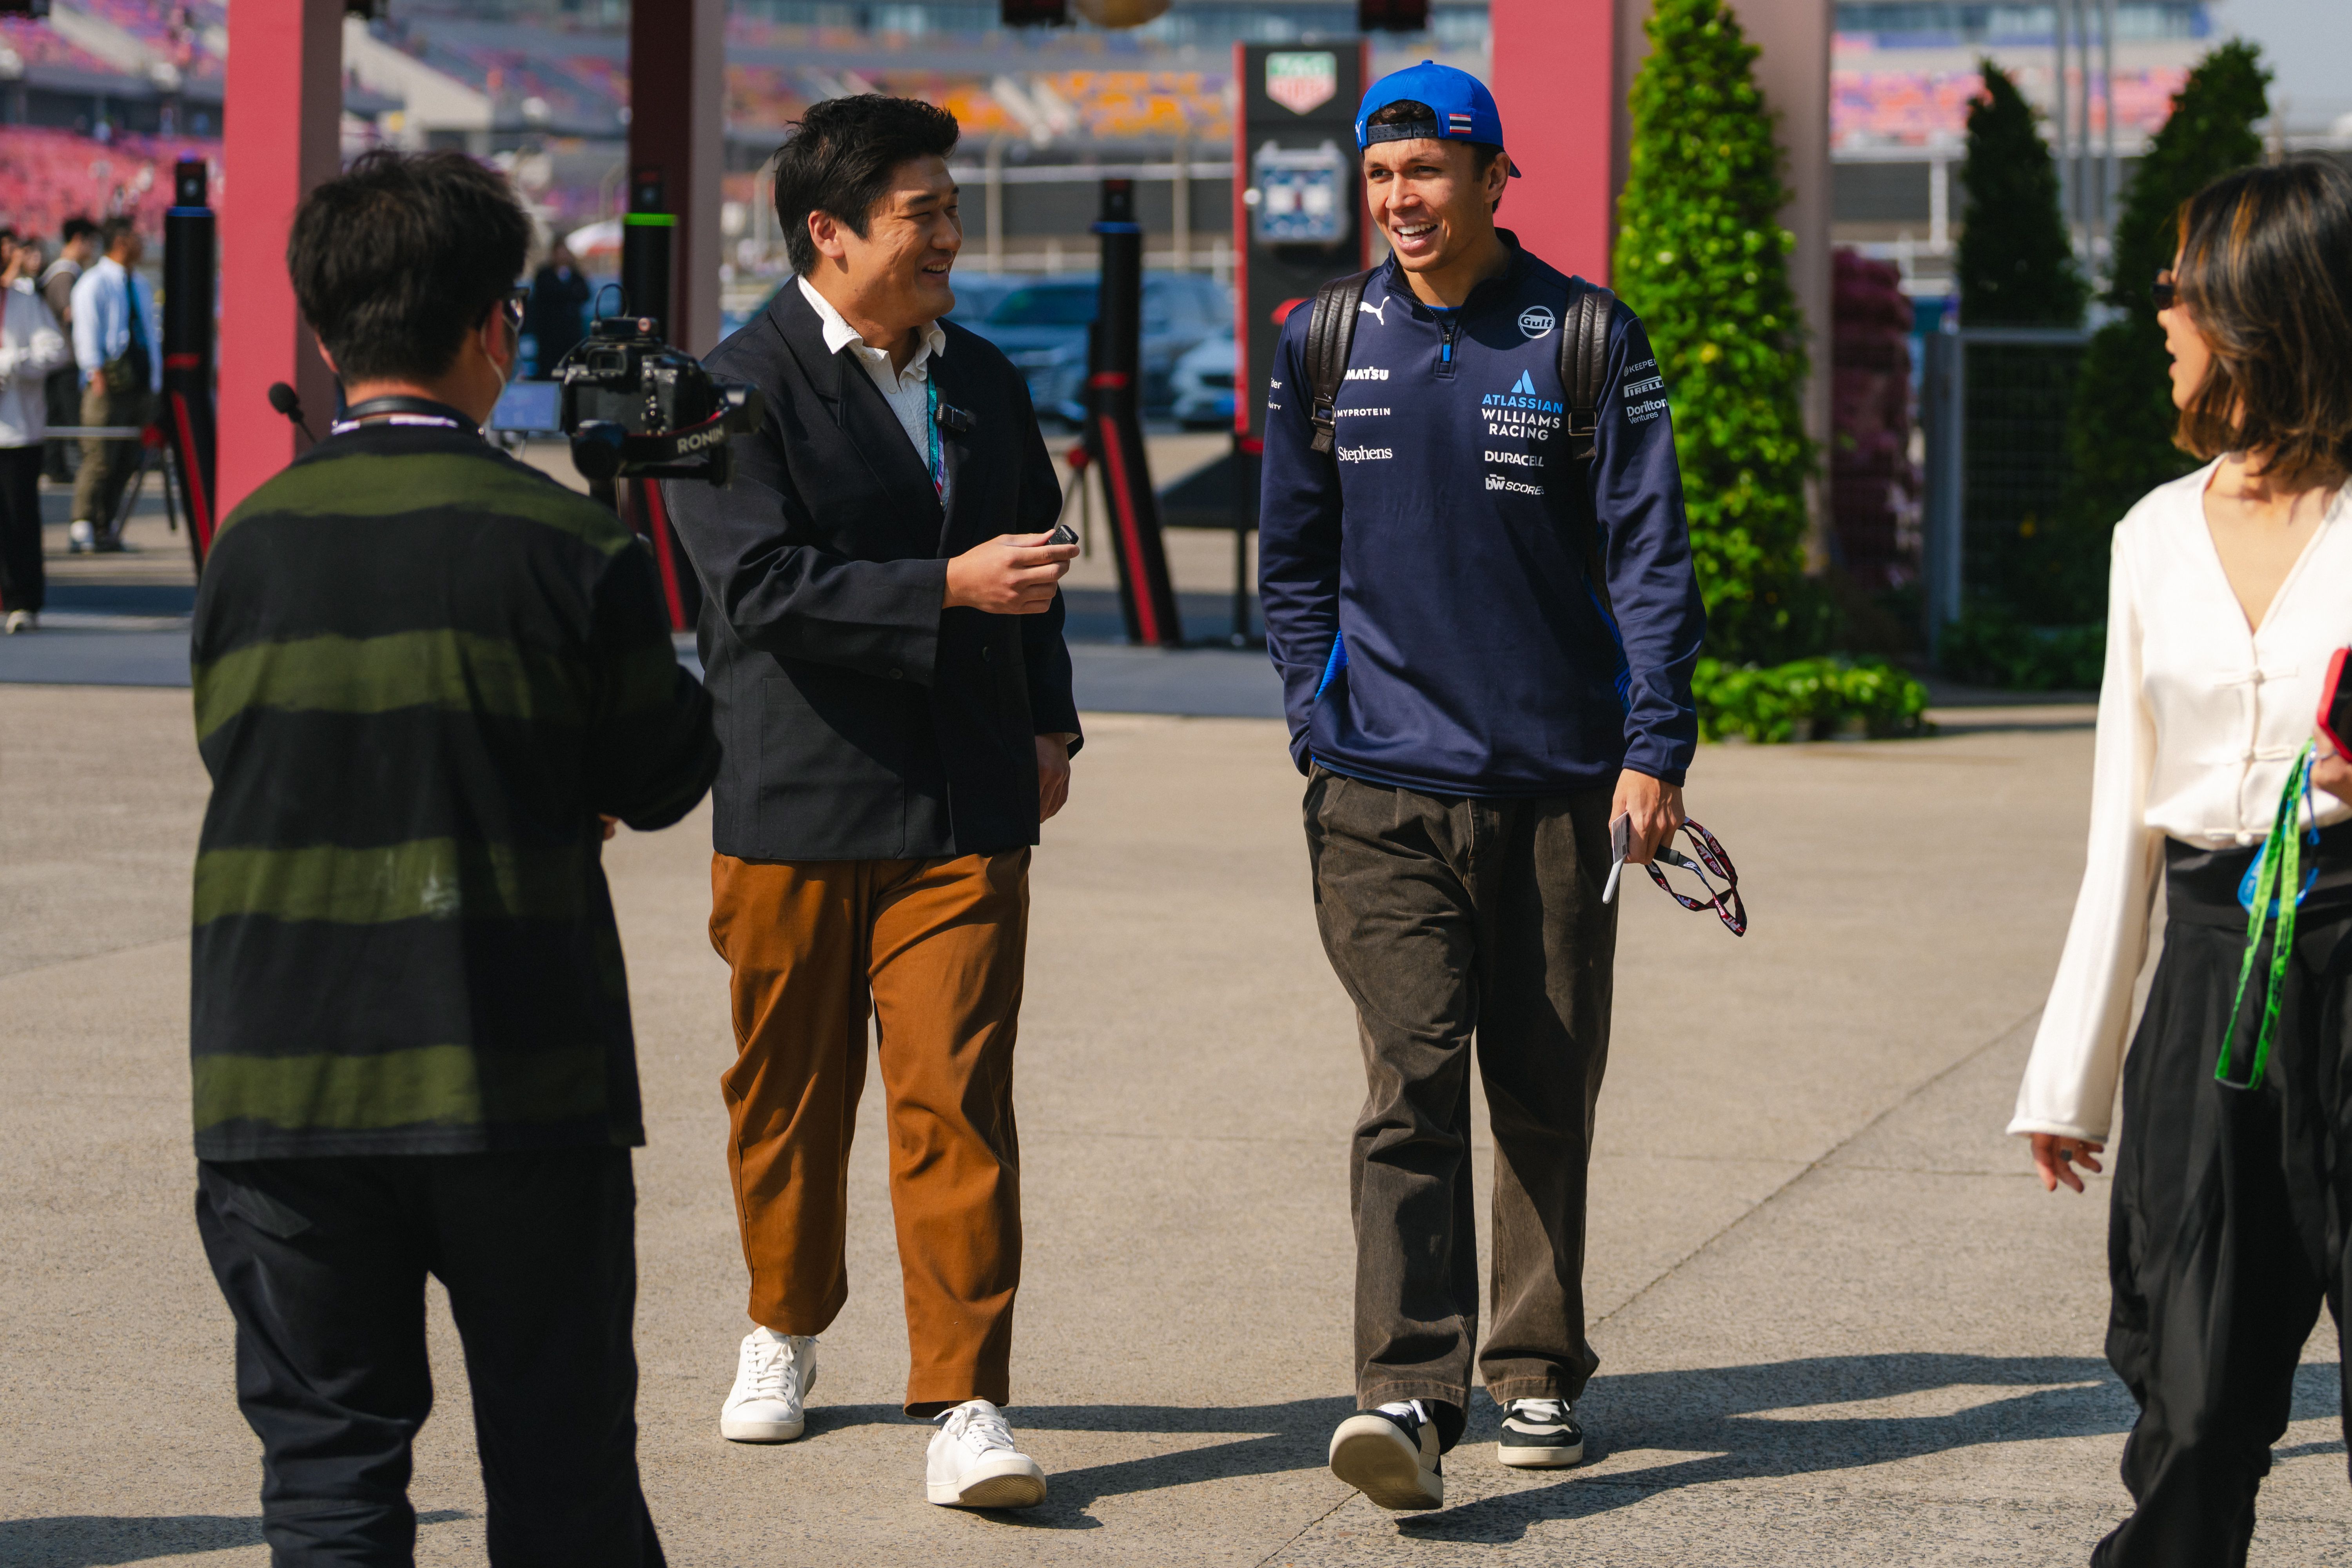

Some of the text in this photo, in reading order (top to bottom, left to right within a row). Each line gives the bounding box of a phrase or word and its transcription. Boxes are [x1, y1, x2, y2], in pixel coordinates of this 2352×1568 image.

[1521, 316, 1553, 327] Gulf
[1344, 366, 1389, 381] MATSU
[1338, 408, 1391, 417] MYPROTEIN
[1482, 394, 1563, 414] ATLASSIAN
[1626, 398, 1668, 417] Dorilton
[1481, 408, 1560, 428] WILLIAMS
[1629, 412, 1659, 424] Ventures
[677, 424, 724, 454] RONIN
[1489, 423, 1548, 441] RACING
[1338, 445, 1393, 463] Stephens
[1485, 450, 1544, 467] DURACELL
[1696, 845, 1722, 875] PIT GRID
[1722, 917, 1740, 931] PIT
